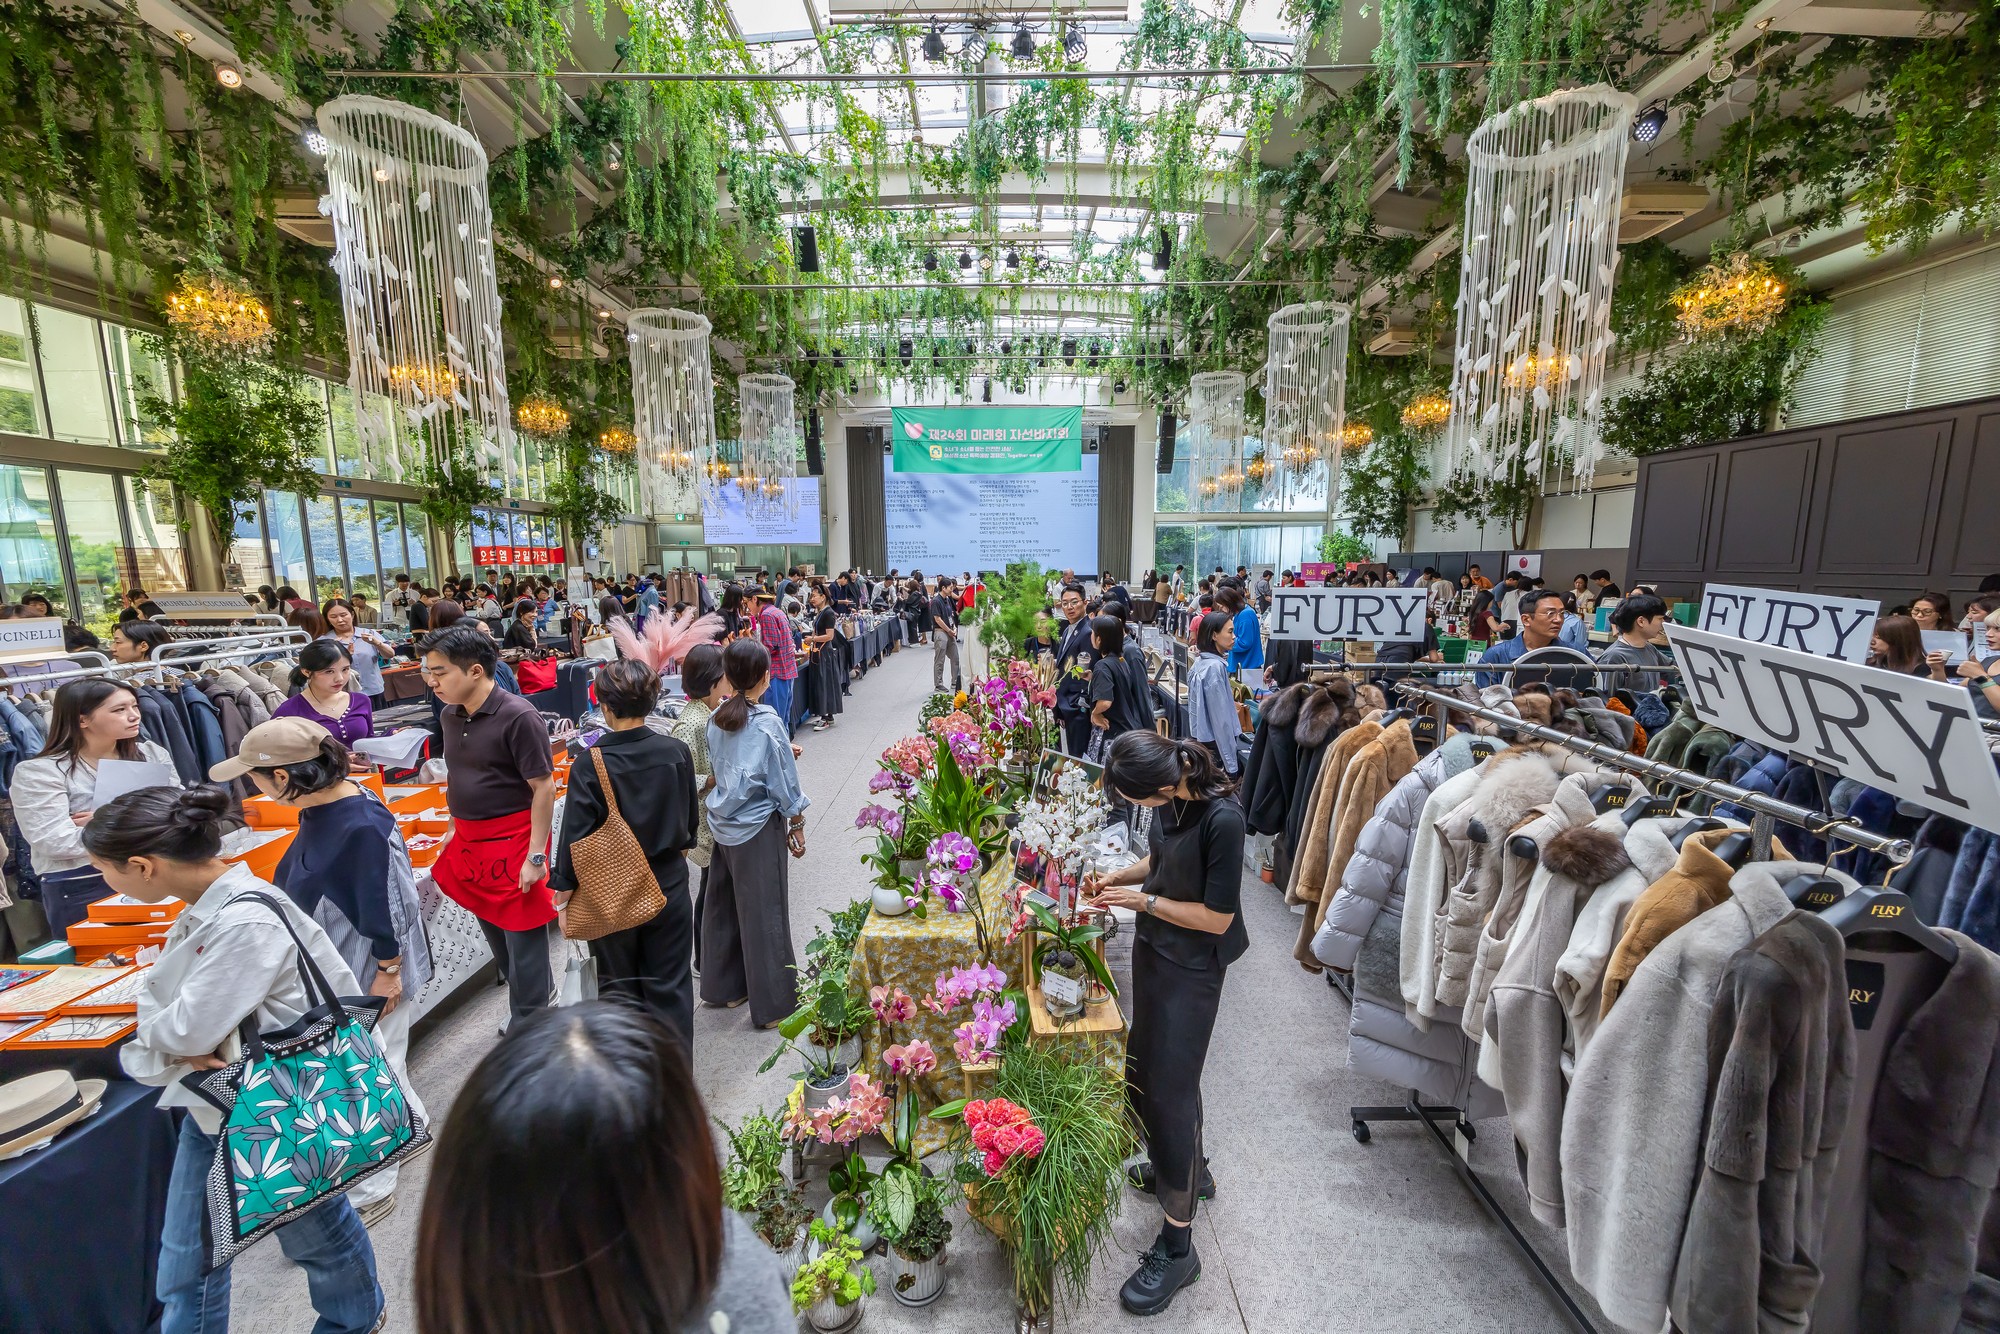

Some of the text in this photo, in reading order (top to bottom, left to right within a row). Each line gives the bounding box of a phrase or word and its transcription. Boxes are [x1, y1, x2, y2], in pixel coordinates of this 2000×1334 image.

[928, 427, 1069, 440] 제24회 미래회 자선바자회
[513, 550, 547, 562] 균일가전
[1273, 594, 1426, 636] FURY
[1704, 591, 1875, 661] FURY
[0, 629, 62, 642] CINELLI
[1671, 638, 1970, 809] FURY
[1607, 795, 1627, 804] FUR
[420, 890, 430, 911] LUV
[427, 894, 440, 922] ELUV
[1807, 892, 1838, 903] FURY
[437, 899, 449, 926] ELUV
[447, 903, 459, 929] ELUV
[1871, 904, 1905, 916] FURY
[466, 913, 475, 936] ELU
[433, 938, 446, 966] ELUV
[443, 941, 456, 969] ELUV
[456, 944, 466, 965] LUV
[465, 947, 476, 968] LUV
[419, 982, 430, 1004] ELU
[281, 1031, 332, 1056] MARNI
